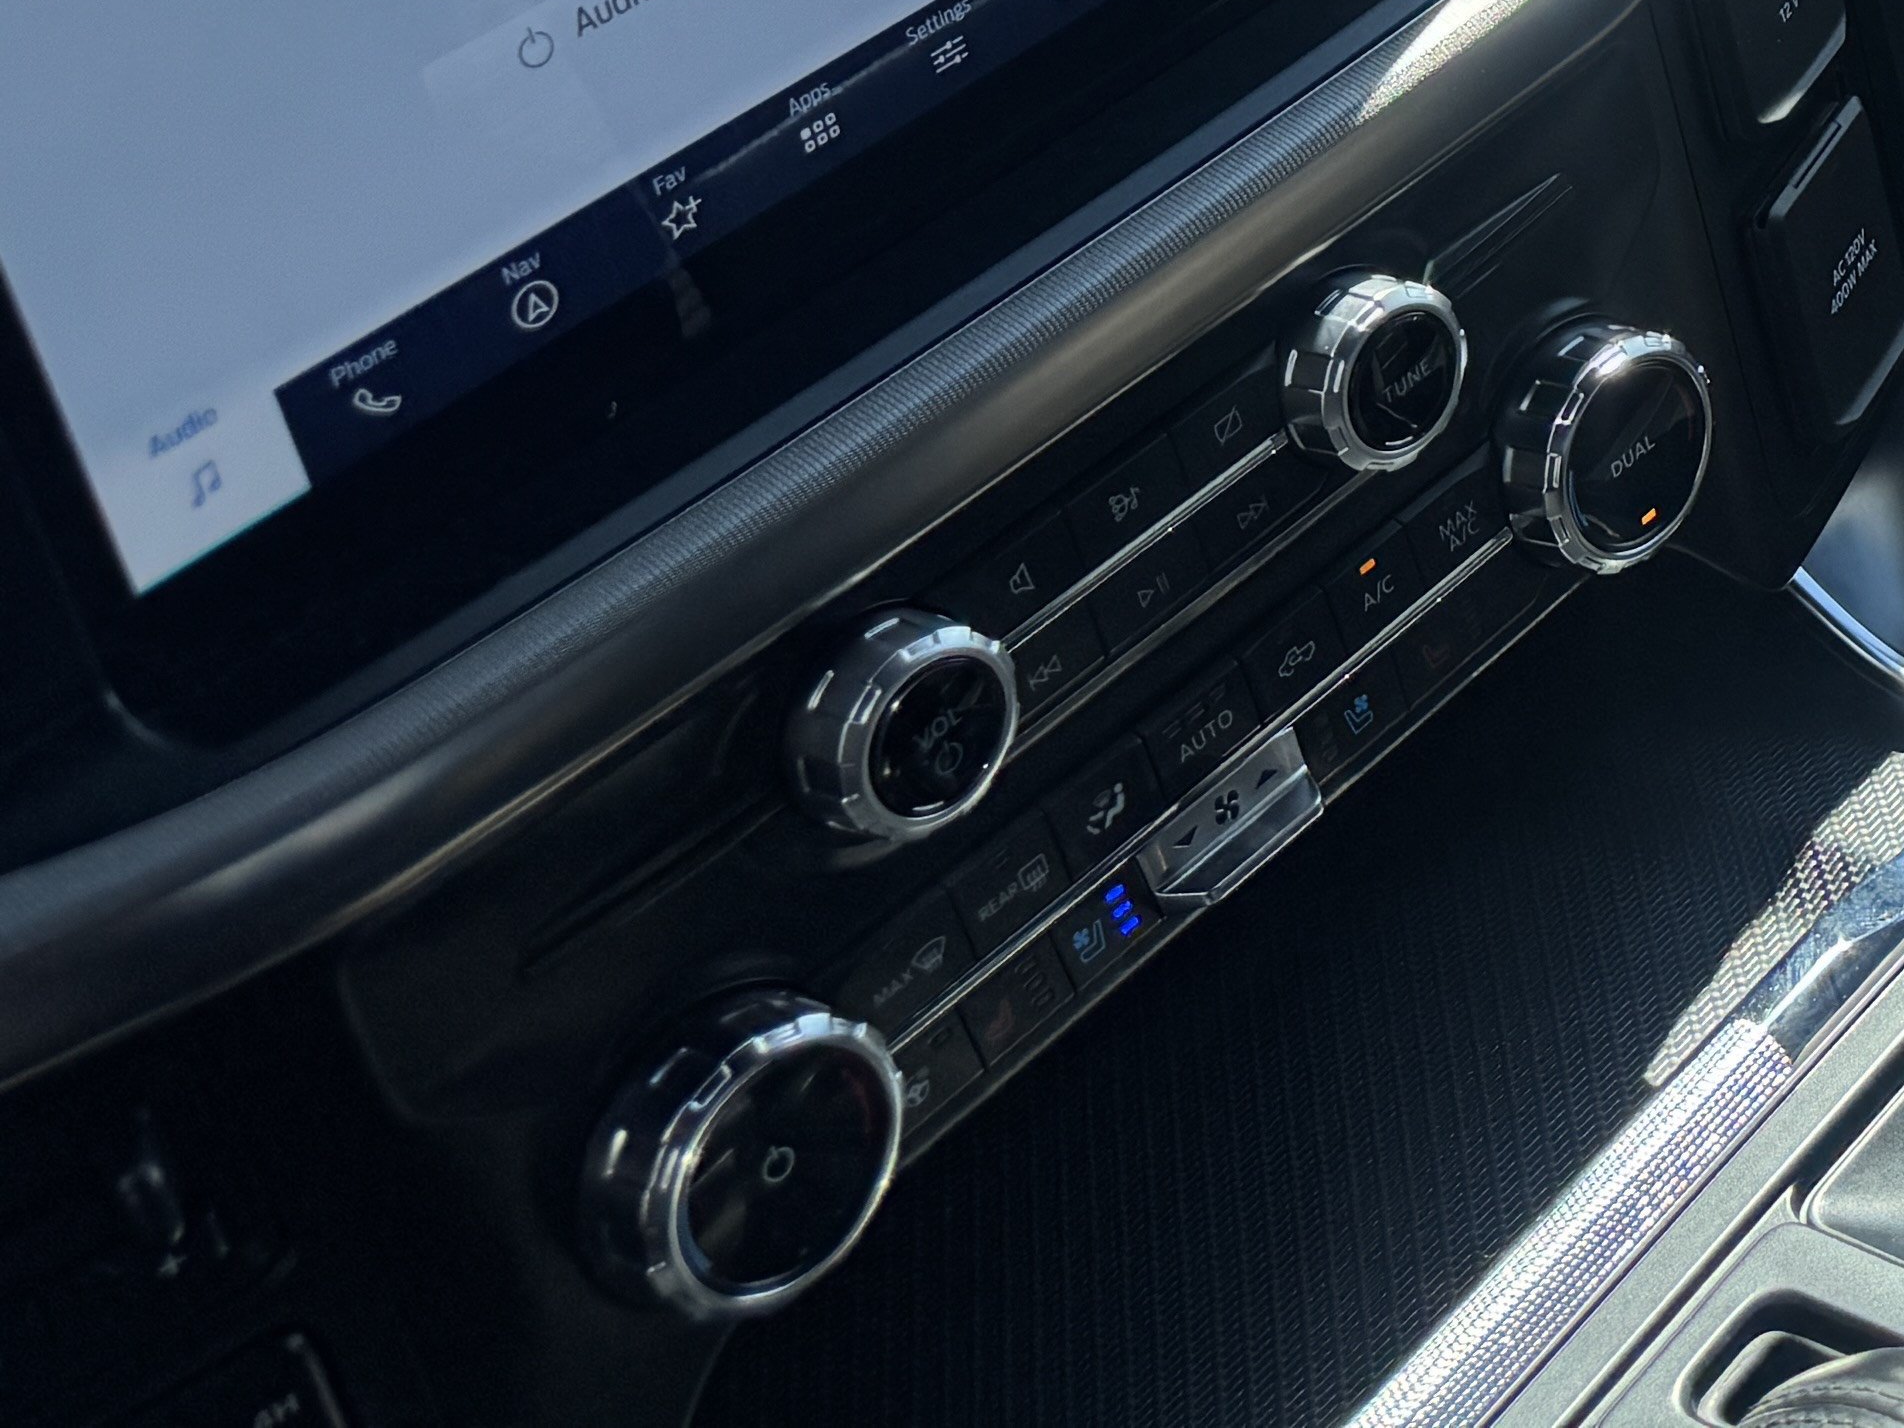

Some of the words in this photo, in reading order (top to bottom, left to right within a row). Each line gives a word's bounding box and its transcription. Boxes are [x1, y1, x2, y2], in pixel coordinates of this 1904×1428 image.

[1776, 1, 1793, 25] 12
[787, 80, 832, 118] Apps
[651, 164, 689, 197] Fav
[500, 250, 544, 286] Nav
[1829, 268, 1858, 316] 400W
[1853, 238, 1880, 276] MAX
[1831, 263, 1848, 288] AC
[329, 338, 401, 390] Phone
[1381, 361, 1434, 404] TUNE
[147, 406, 219, 460] Audio
[1608, 434, 1657, 480] DUAL
[1436, 499, 1480, 542] MAX
[1447, 518, 1481, 553] A/C
[1361, 573, 1396, 613] A/C
[910, 707, 964, 754] VOL
[1177, 709, 1234, 765] AUTO
[976, 880, 1019, 924] REAR
